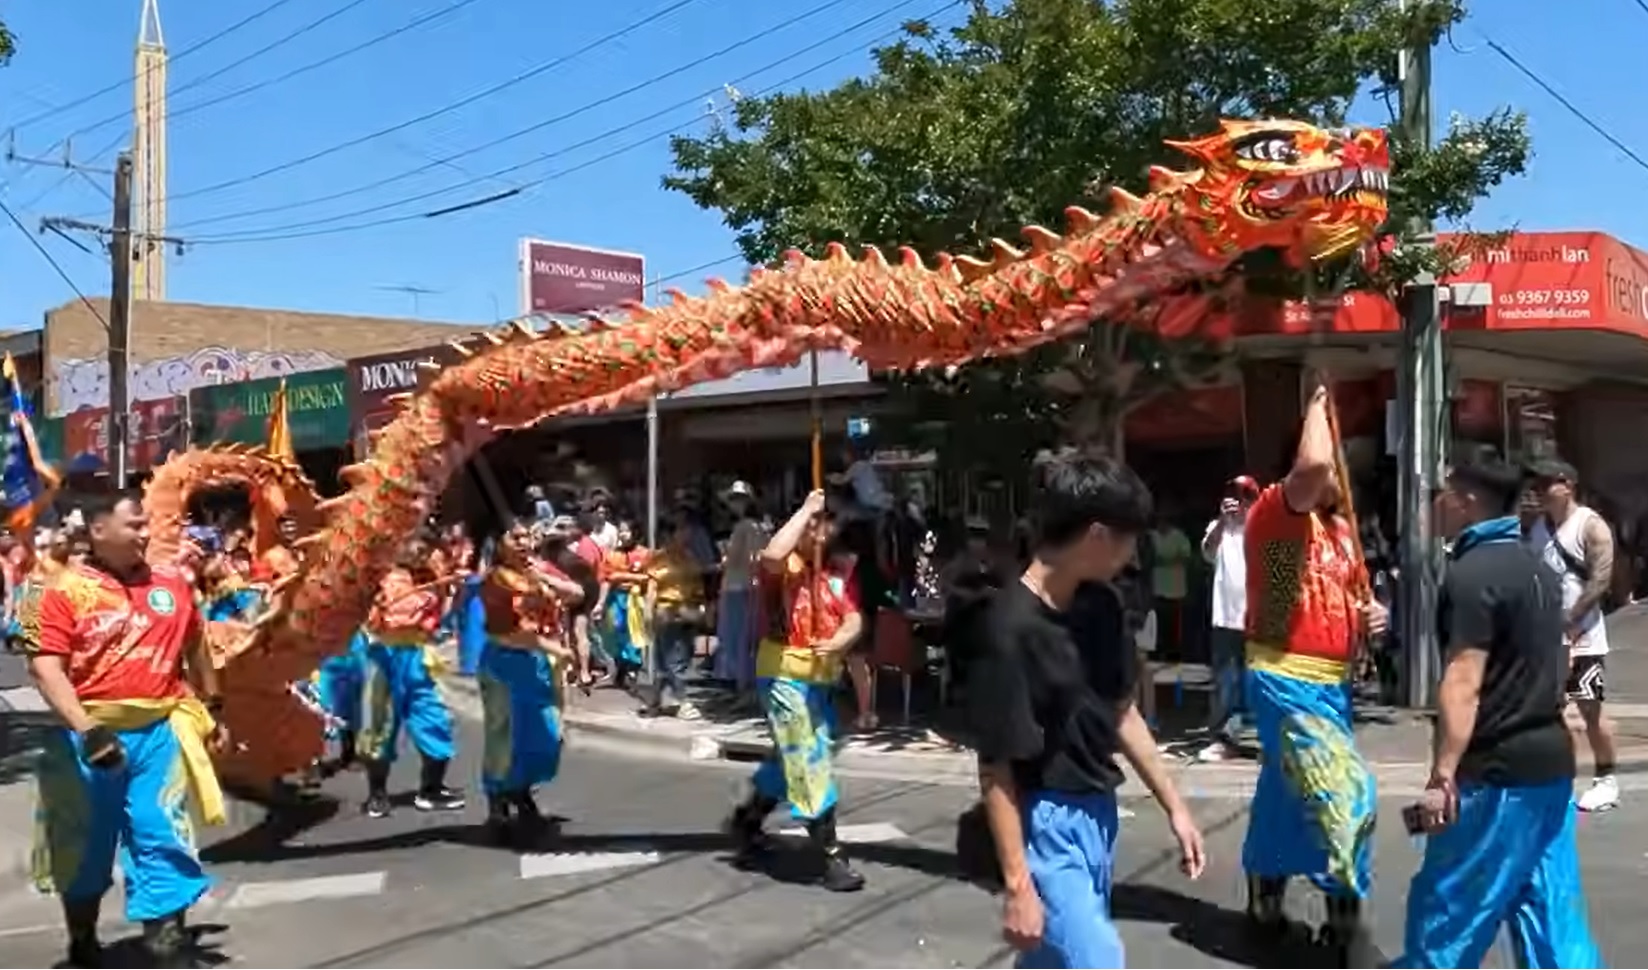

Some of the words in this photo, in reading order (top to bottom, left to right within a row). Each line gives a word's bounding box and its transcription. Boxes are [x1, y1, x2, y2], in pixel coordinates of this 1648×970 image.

[534, 260, 587, 279] MONICA
[590, 267, 641, 285] SHAMON
[1499, 293, 1513, 304] 03
[1516, 290, 1551, 305] 9367
[1554, 289, 1590, 304] 9359
[286, 381, 344, 412] DESIGN
